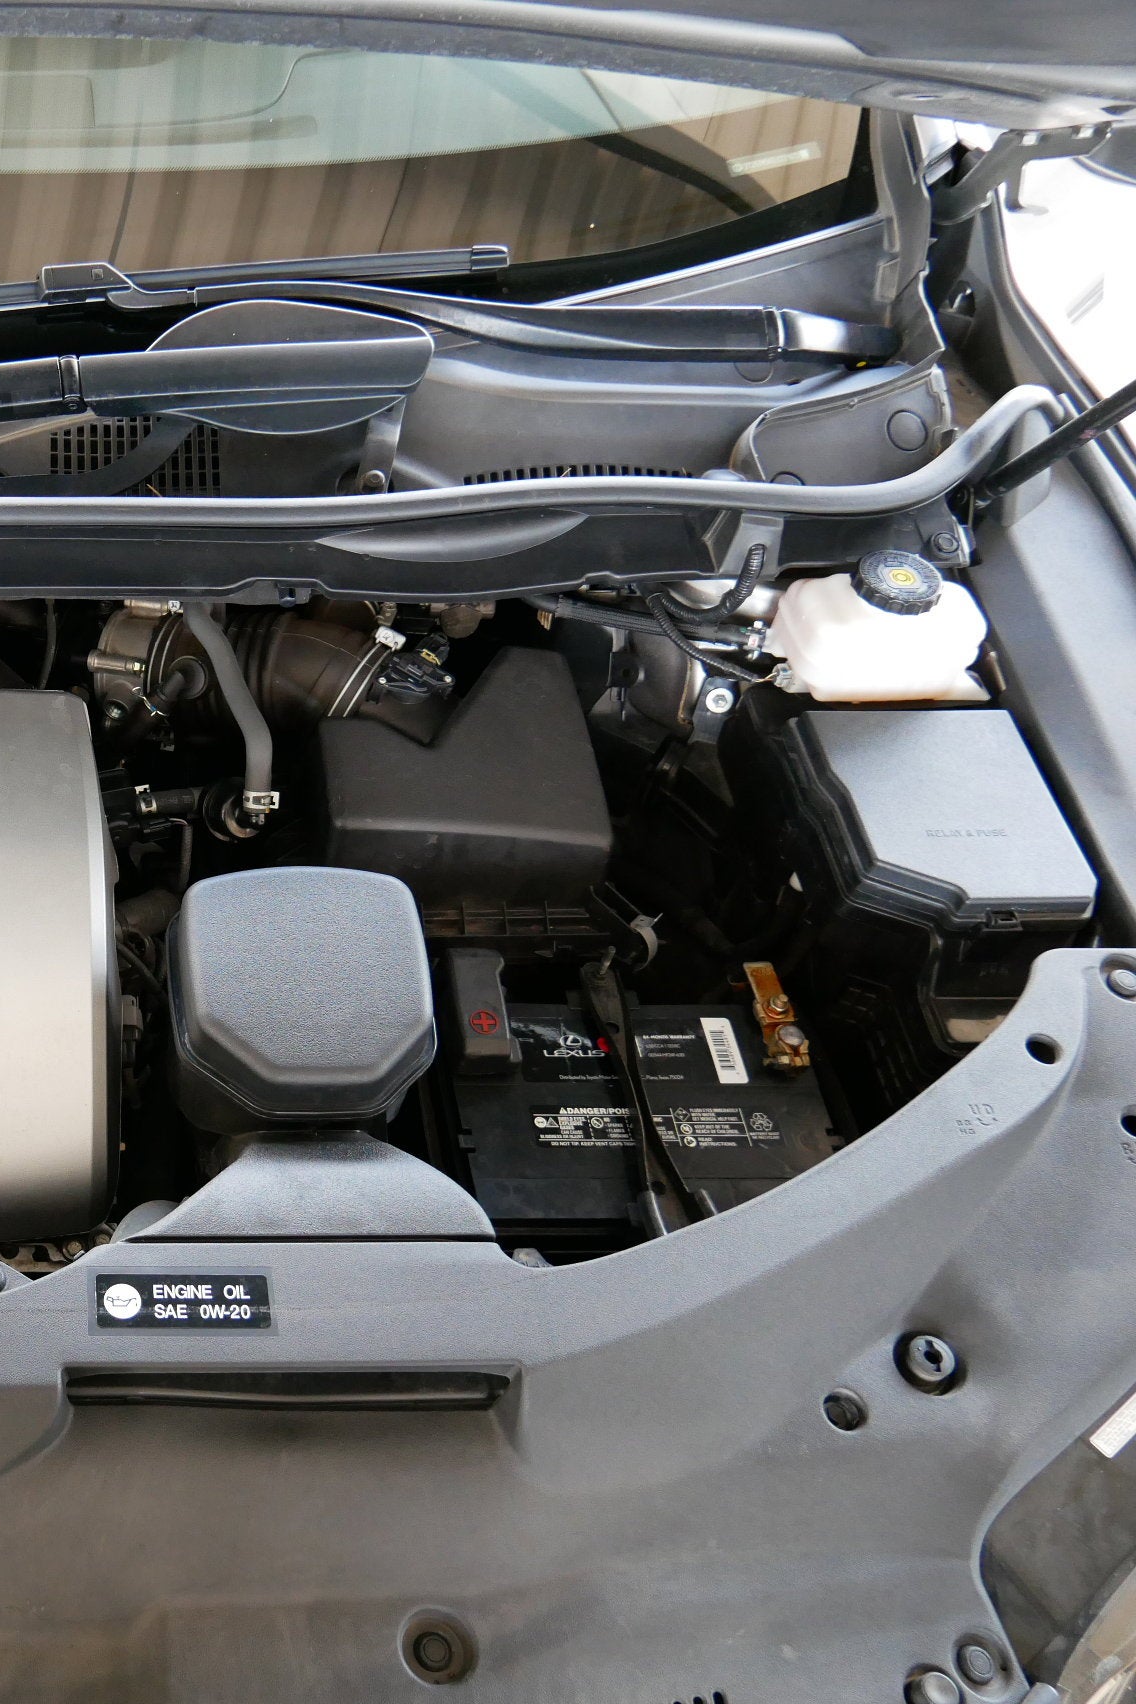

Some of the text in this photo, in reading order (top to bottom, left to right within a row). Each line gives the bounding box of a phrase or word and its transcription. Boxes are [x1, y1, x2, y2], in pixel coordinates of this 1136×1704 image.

[976, 829, 1008, 838] FUSE
[153, 1284, 251, 1299] ENGINE OIL
[154, 1304, 251, 1319] SAE 0W-20
